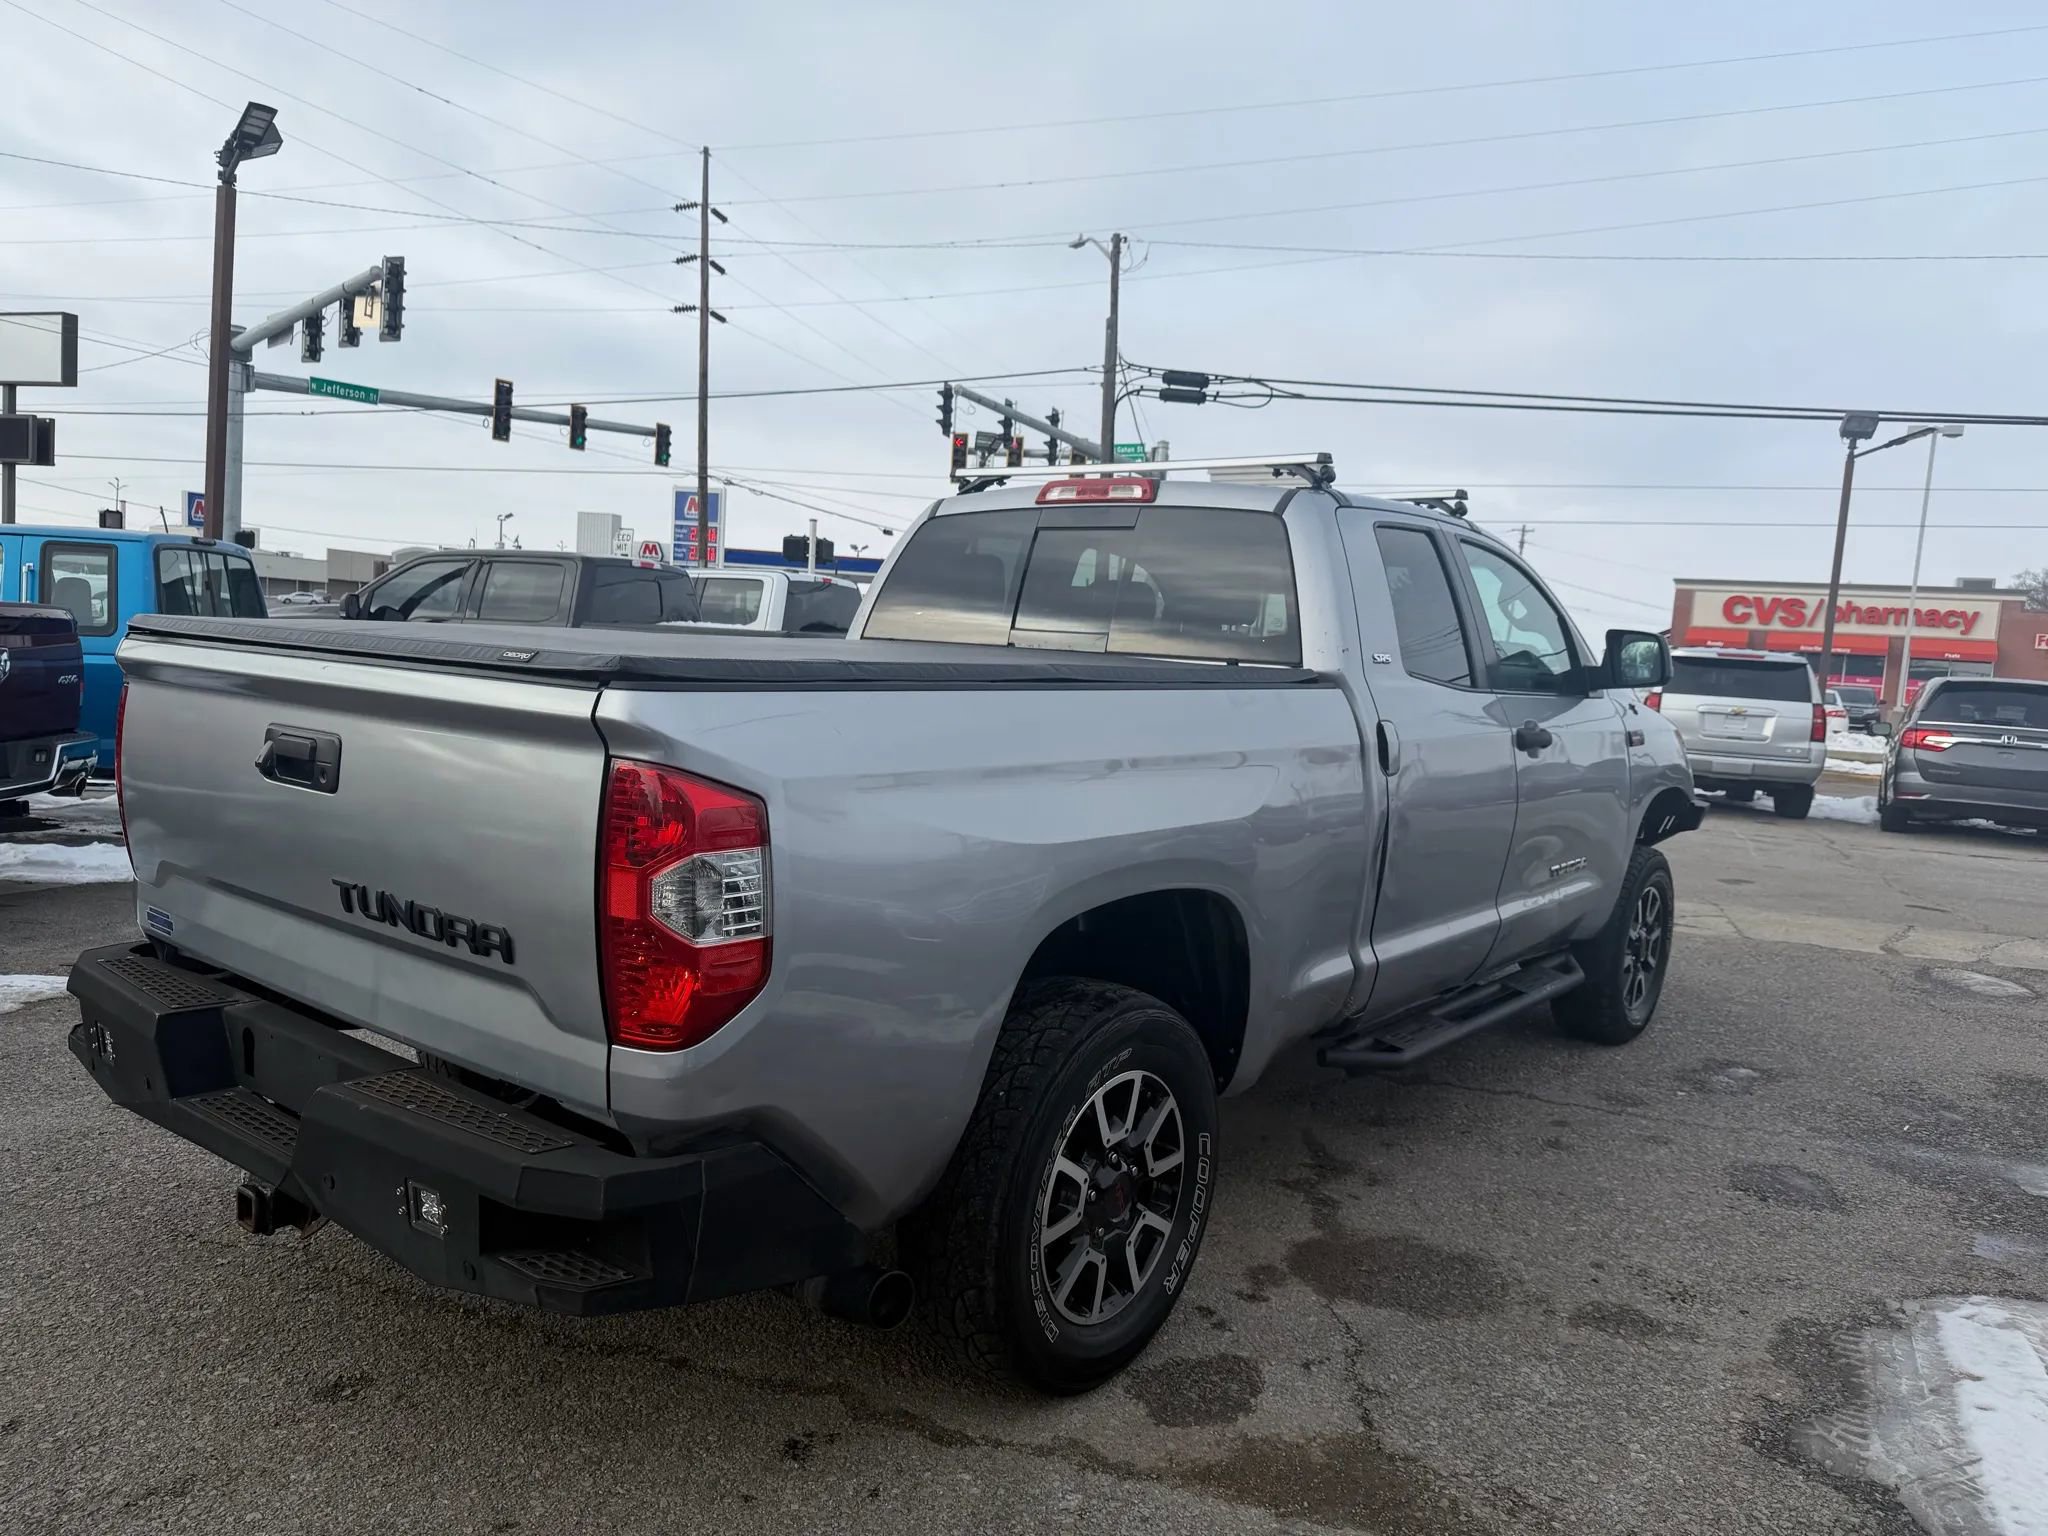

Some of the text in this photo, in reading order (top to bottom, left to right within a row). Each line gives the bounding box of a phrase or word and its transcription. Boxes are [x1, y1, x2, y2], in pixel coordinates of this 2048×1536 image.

[321, 383, 366, 399] Jefferson
[331, 879, 515, 965] TUNDRA
[1163, 1132, 1211, 1295] COOPER
